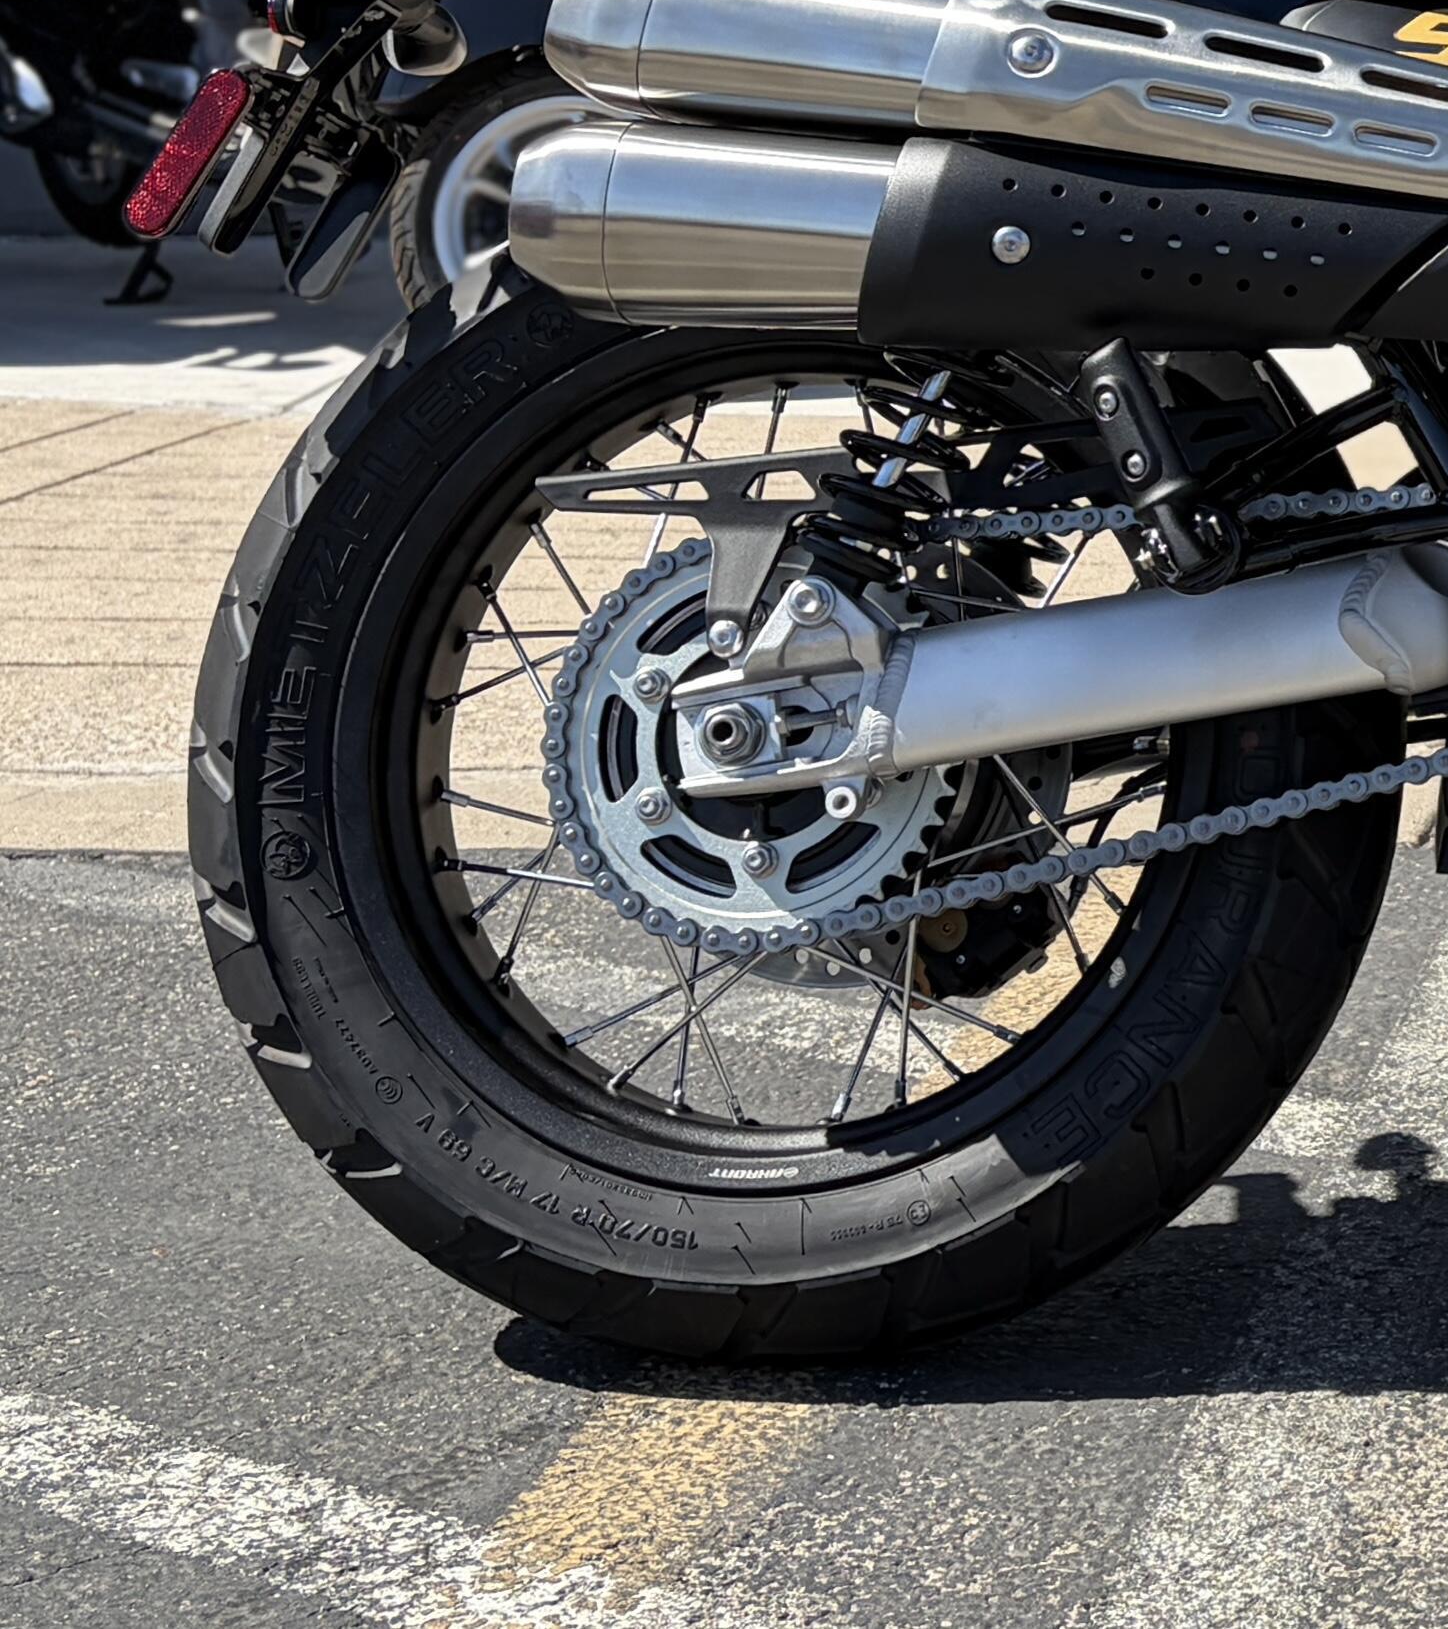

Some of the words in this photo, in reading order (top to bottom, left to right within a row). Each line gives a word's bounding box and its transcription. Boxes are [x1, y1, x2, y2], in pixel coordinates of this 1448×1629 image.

[1028, 750, 1283, 1171] OURANCE
[412, 1108, 439, 1136] V
[530, 1187, 559, 1215] 17
